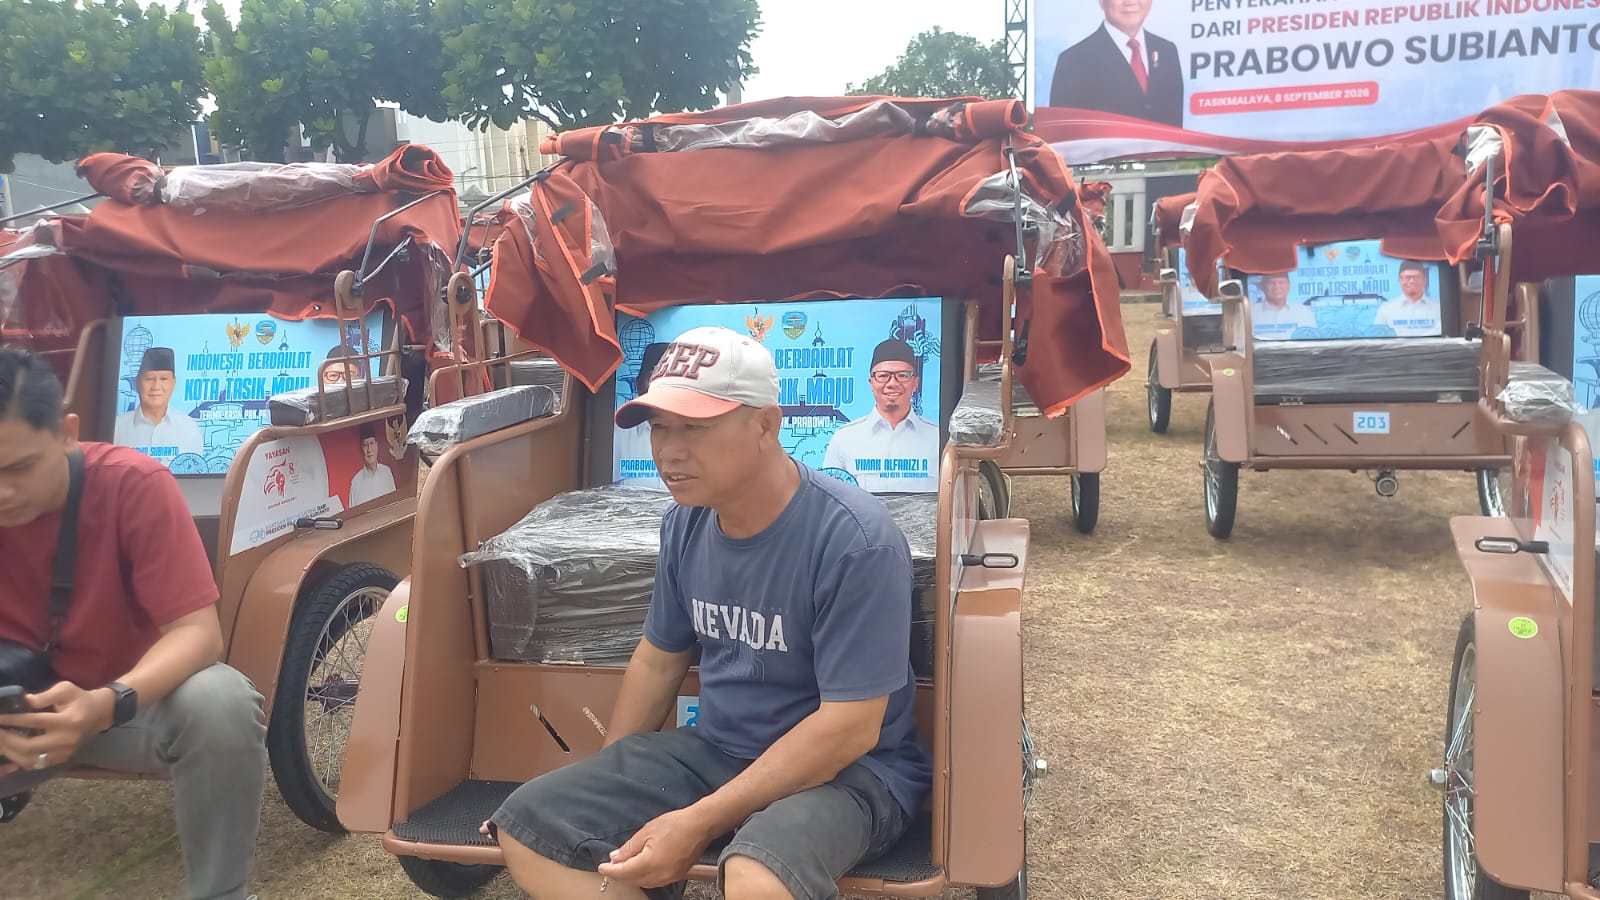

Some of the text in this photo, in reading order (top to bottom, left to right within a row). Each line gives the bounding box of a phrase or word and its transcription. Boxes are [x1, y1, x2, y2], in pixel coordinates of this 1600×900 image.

[1191, 20, 1241, 39] DARI
[1247, 9, 1359, 34] PRESIDEN
[1364, 0, 1480, 26] REPUBLIK
[1190, 38, 1394, 80] PRABOWO
[1283, 89, 1342, 103] SEPTEMBER
[1297, 279, 1390, 296] KOTA TASIK MAJU
[186, 351, 312, 371] INDONESIA BERDAULAT
[650, 342, 720, 381] EEP
[775, 346, 855, 370] BERDAULAT
[184, 377, 220, 401] KOTA
[226, 376, 267, 400] TASIK
[806, 376, 854, 409] MAJU
[791, 415, 830, 428] PRABOWO
[1357, 416, 1386, 429] 203
[264, 446, 290, 461] YAYASAN
[620, 459, 657, 471] PRABOWO
[855, 458, 881, 471] VIMAN
[884, 458, 919, 471] ALFARIZI
[692, 598, 788, 652] NEVADA
